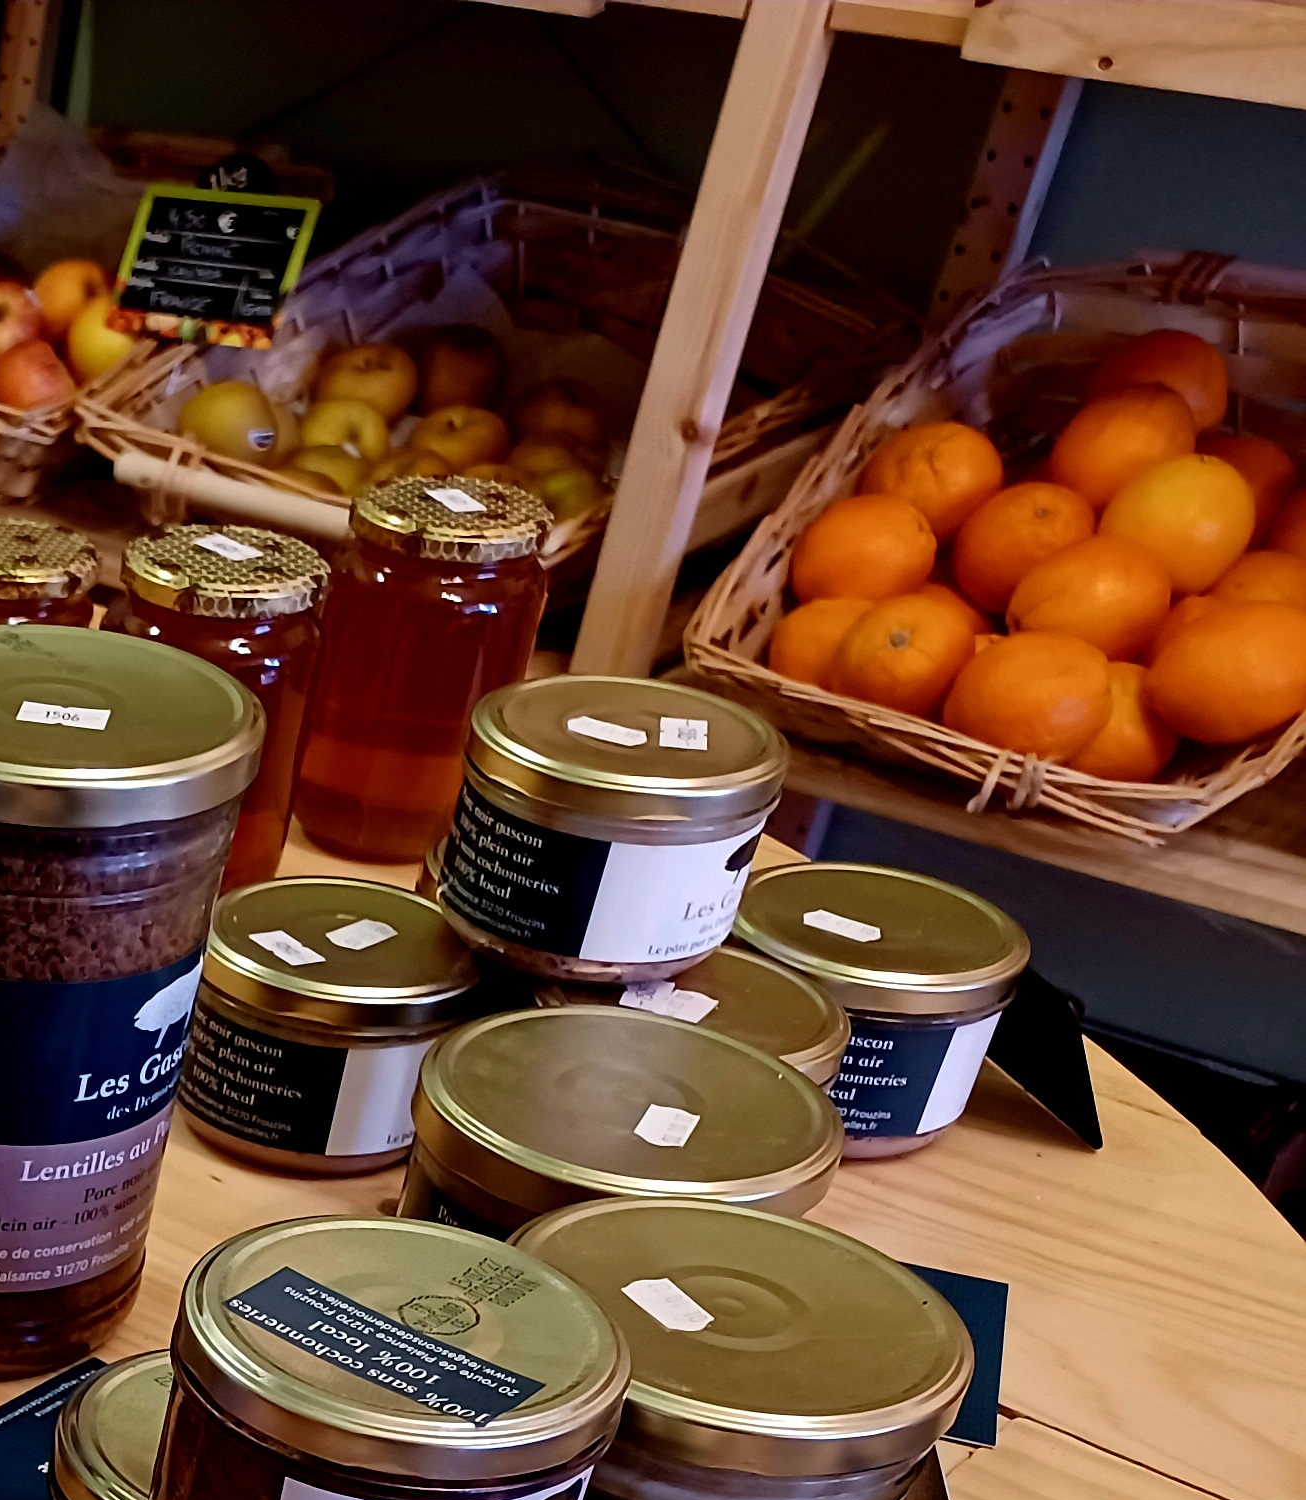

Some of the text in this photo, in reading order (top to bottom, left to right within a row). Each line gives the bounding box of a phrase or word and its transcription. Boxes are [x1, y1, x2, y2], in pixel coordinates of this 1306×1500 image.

[44, 709, 80, 723] 1506
[234, 1035, 282, 1058] gascon
[74, 1074, 129, 1103] Les
[223, 1083, 255, 1105] local
[20, 1151, 124, 1182] Lentilles
[32, 1218, 57, 1232] air
[227, 1298, 363, 1371] cochonneries
[307, 1319, 441, 1386] 100% local
[366, 1367, 418, 1398] sans
